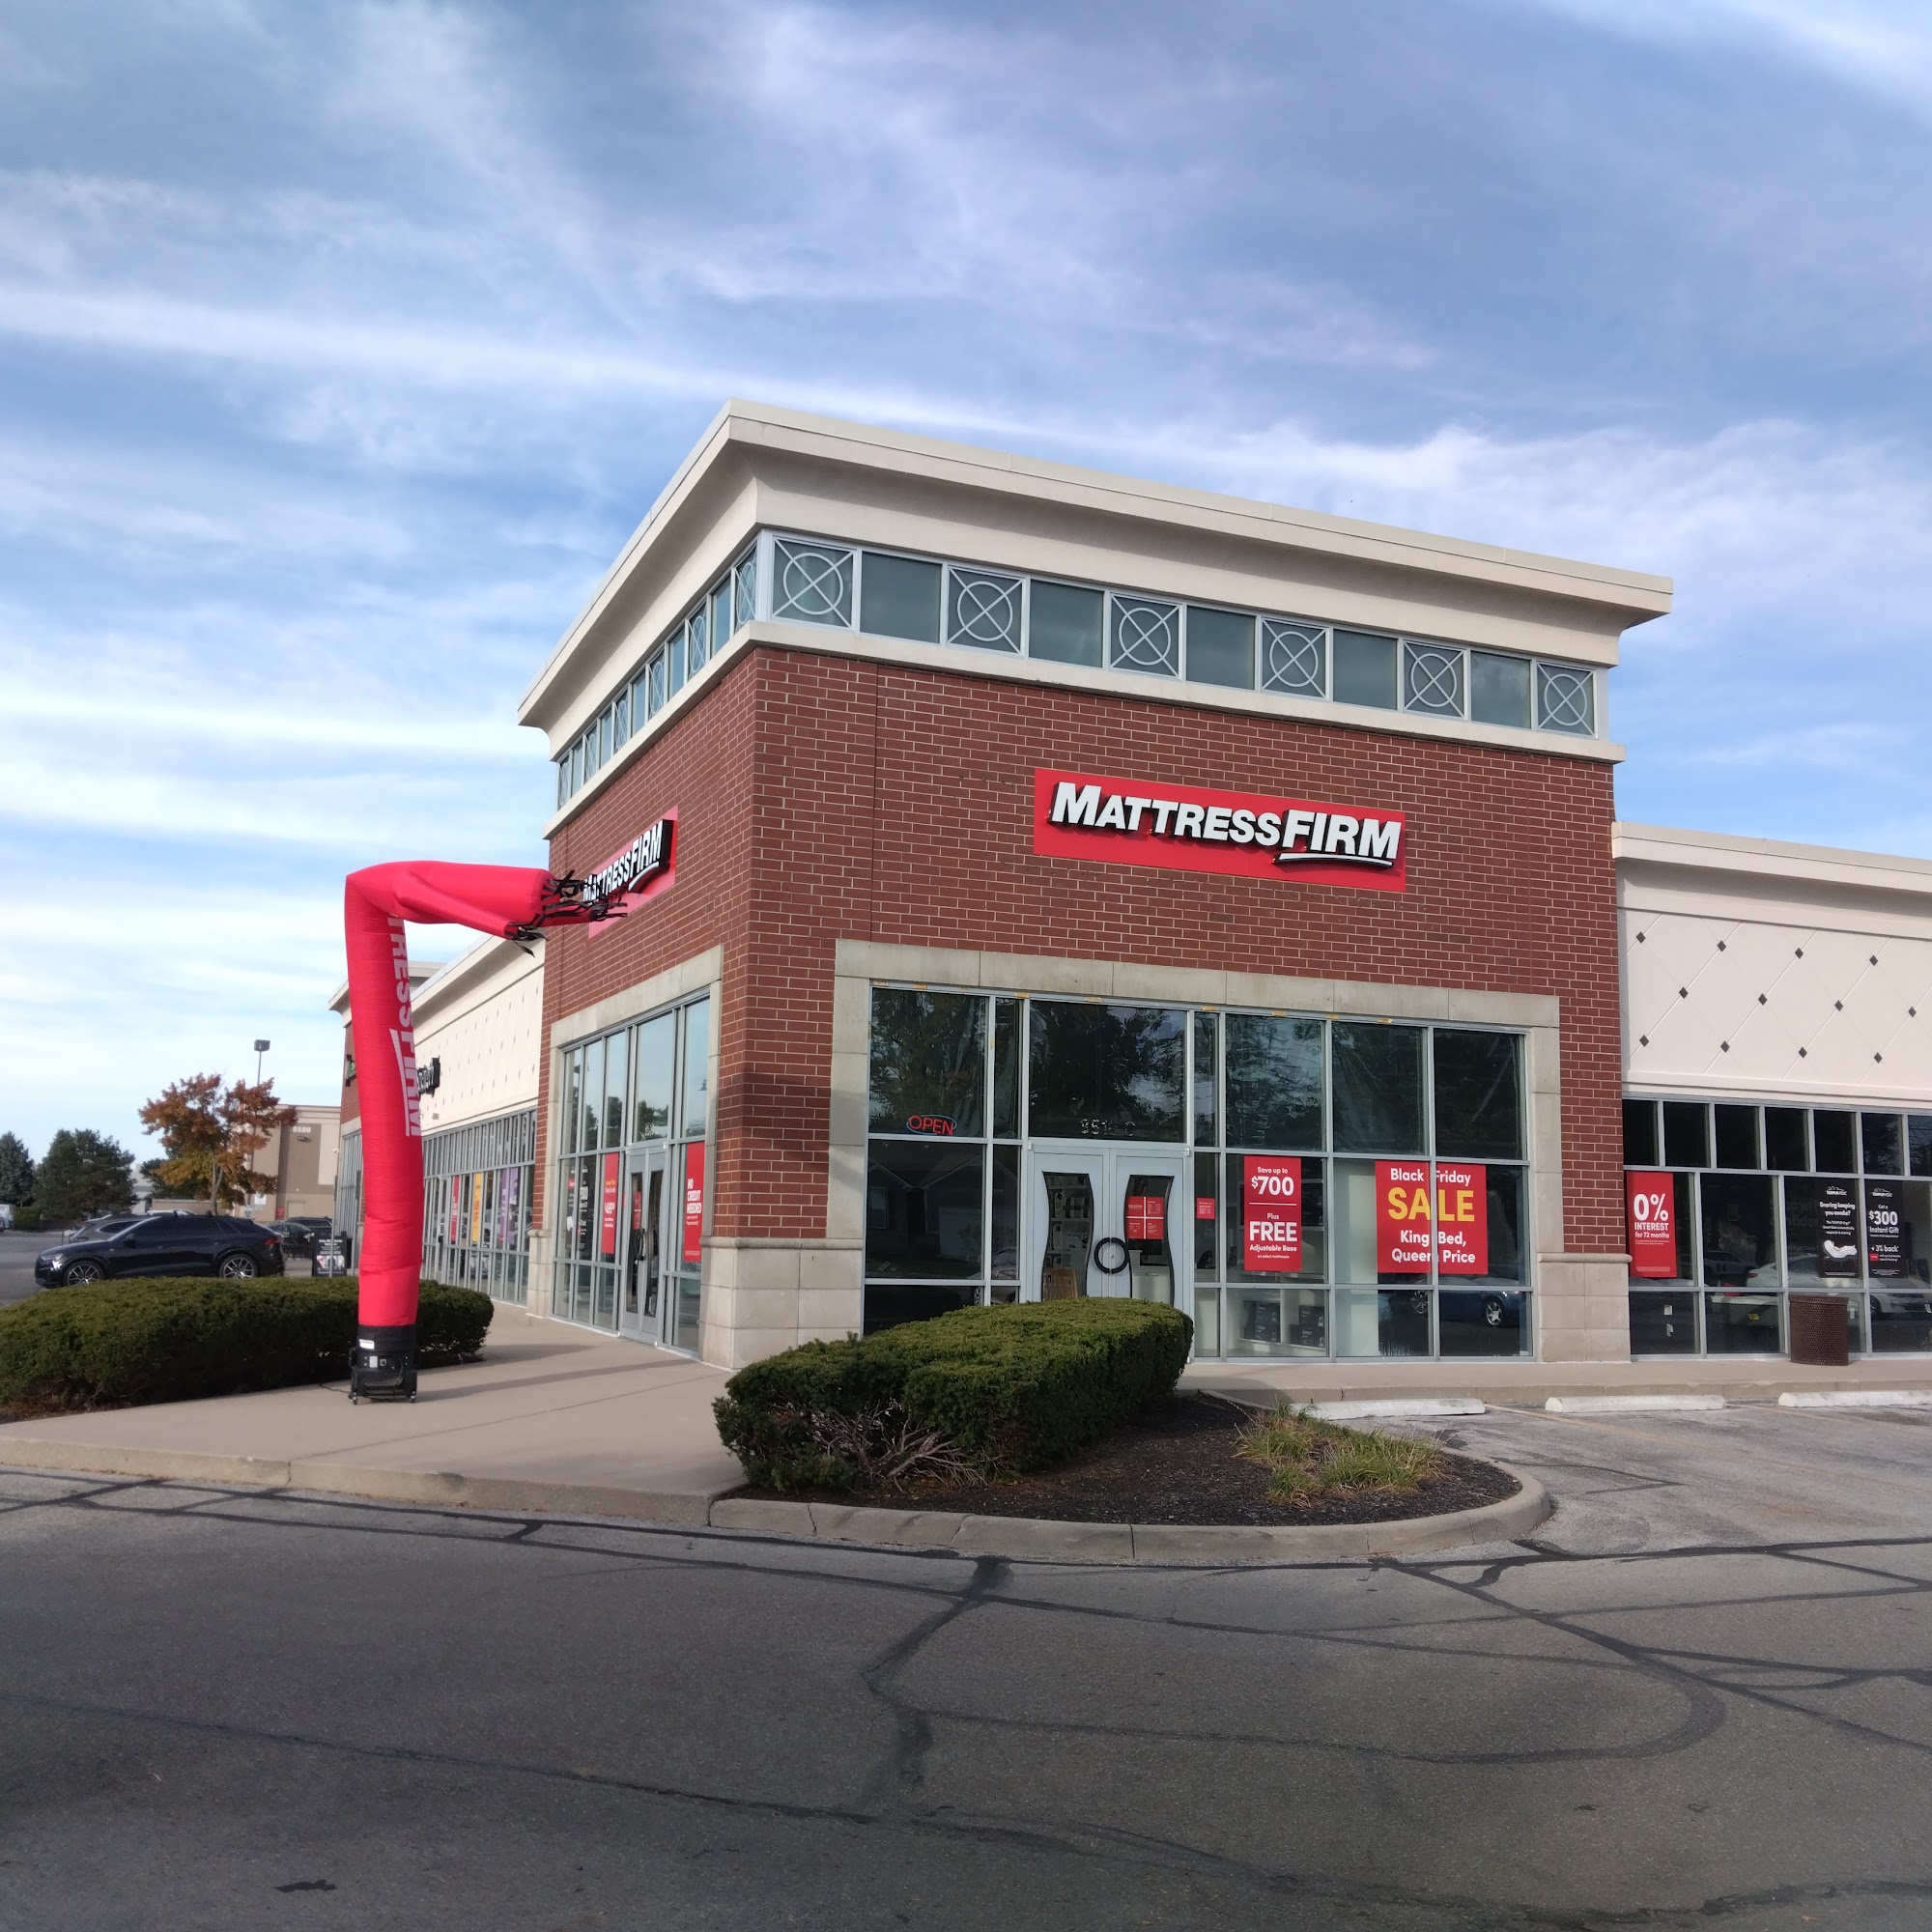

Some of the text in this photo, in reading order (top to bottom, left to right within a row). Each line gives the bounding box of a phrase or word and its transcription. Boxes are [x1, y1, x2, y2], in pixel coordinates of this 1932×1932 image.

[1051, 781, 1402, 862] MATTRESSFIRM
[908, 1116, 953, 1136] OPEN
[1273, 1167, 1281, 1176] up
[1390, 1168, 1425, 1181] Black
[1251, 1176, 1294, 1196] $700
[1387, 1186, 1475, 1222] SALE
[1634, 1193, 1669, 1221] 0%
[1868, 1209, 1898, 1226] $300
[1249, 1221, 1297, 1242] FREE
[1634, 1222, 1669, 1232] INTEREST
[1400, 1230, 1467, 1247] King Bed,
[1249, 1243, 1282, 1252] Adjustable
[1442, 1249, 1476, 1264] Price
